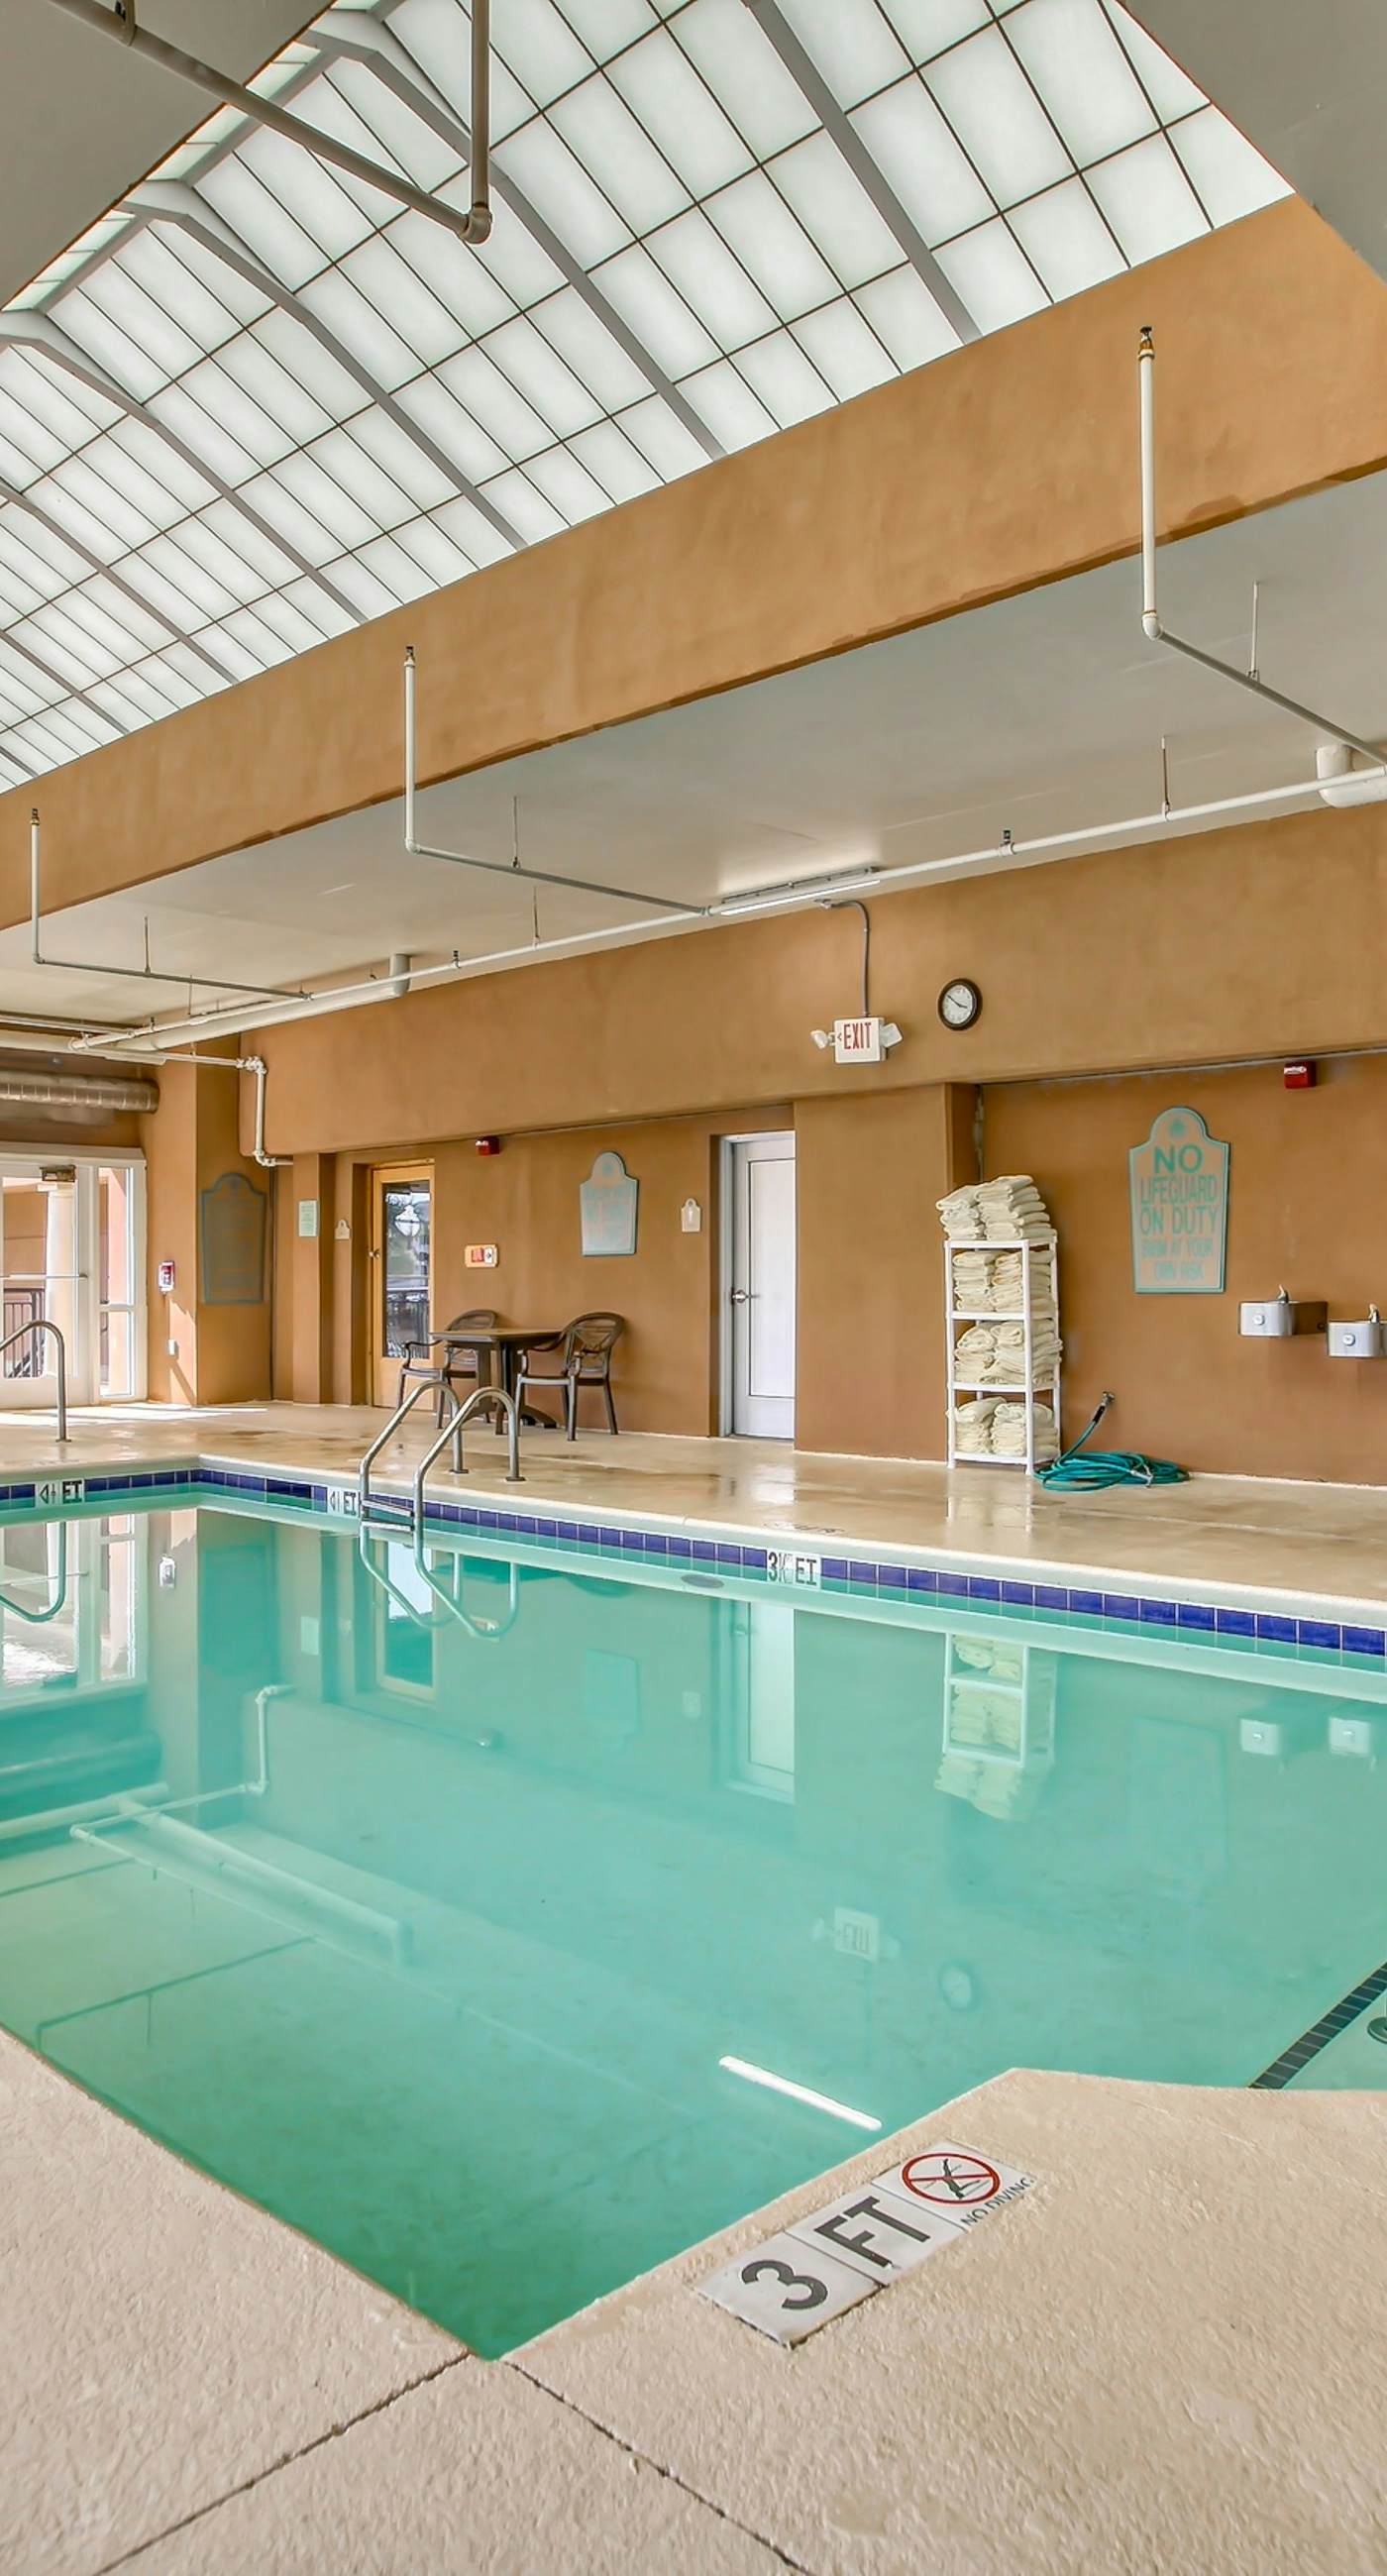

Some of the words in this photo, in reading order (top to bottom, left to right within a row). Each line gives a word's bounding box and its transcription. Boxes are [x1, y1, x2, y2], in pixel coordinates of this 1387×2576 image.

[843, 1021, 871, 1049] EXIT
[1154, 1144, 1204, 1174] NO
[1141, 1175, 1218, 1204] LIFEGUARD
[1141, 1207, 1165, 1235] ON
[1173, 1205, 1218, 1234] DUTY
[960, 2208, 989, 2226] NO
[741, 2260, 828, 2310] 3
[814, 2196, 931, 2268] FT
